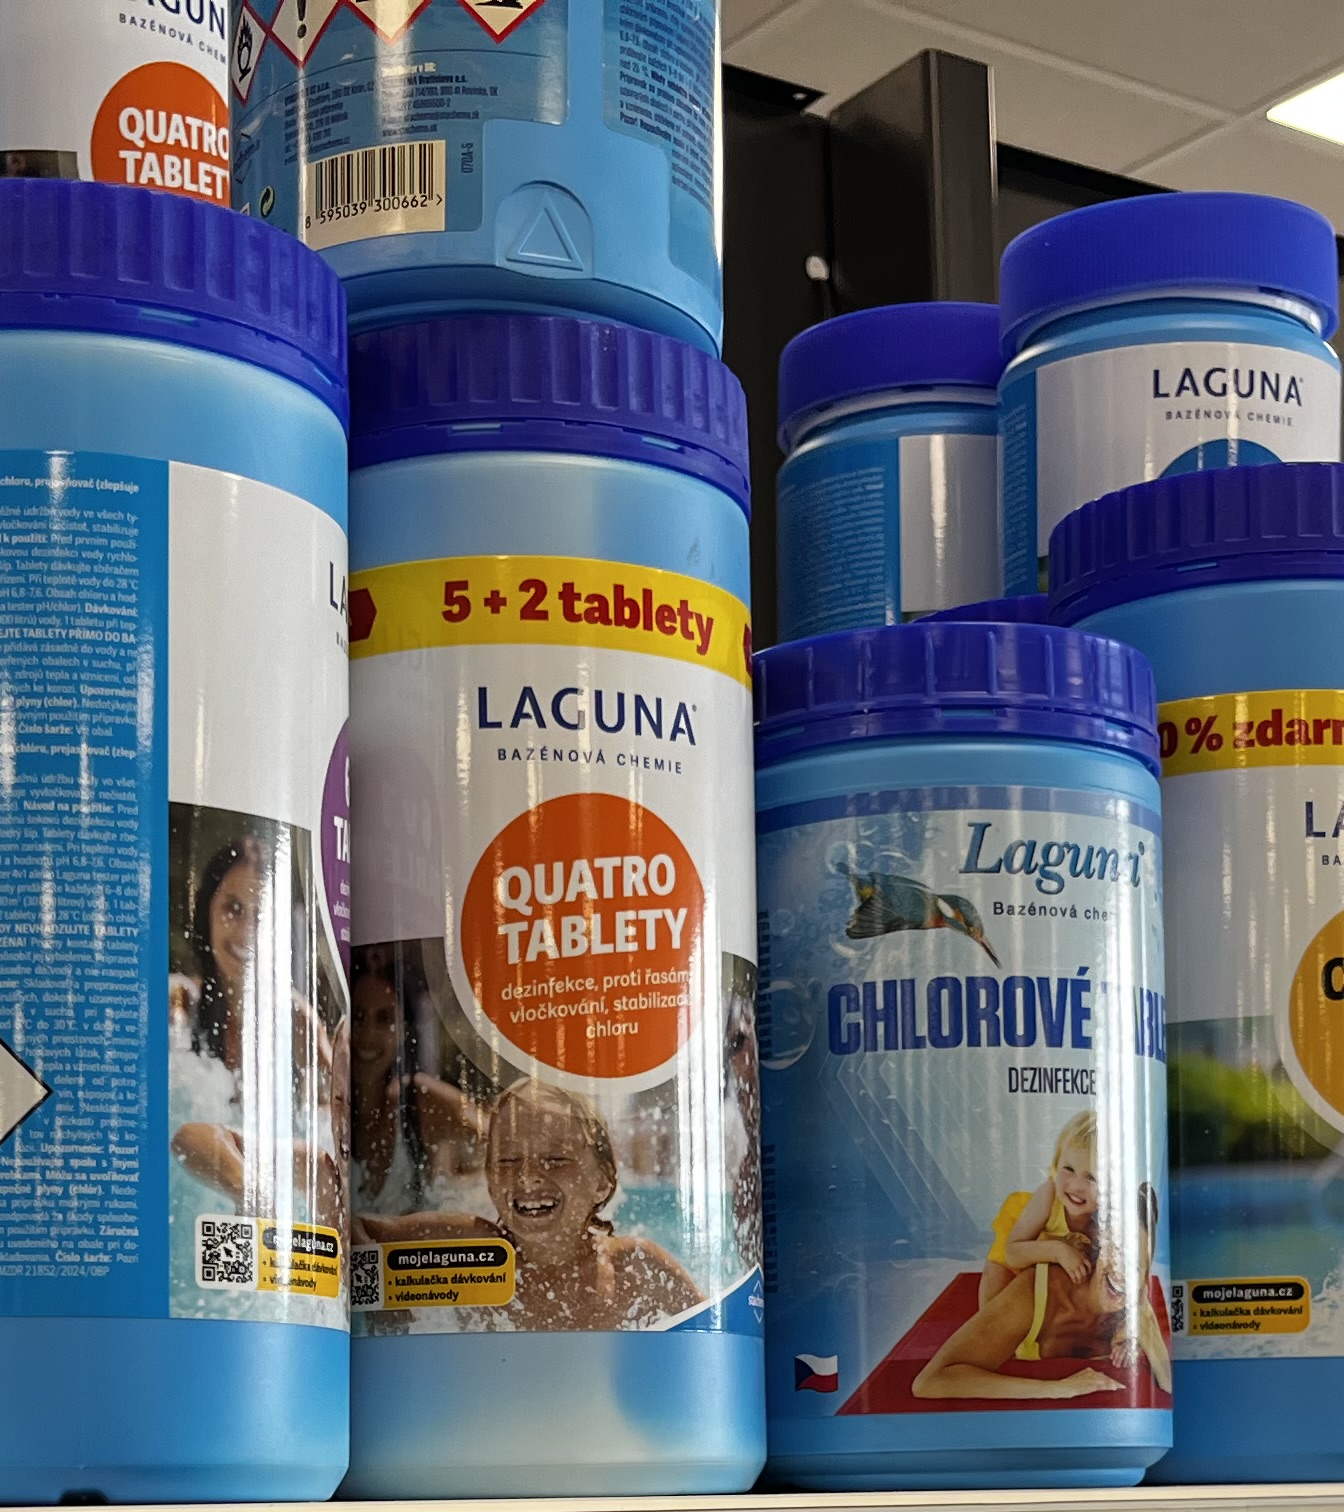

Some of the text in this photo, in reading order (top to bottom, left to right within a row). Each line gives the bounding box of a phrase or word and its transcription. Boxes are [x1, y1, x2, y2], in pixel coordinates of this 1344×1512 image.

[119, 106, 230, 157] QUATRO
[318, 193, 429, 226] 595039 300662
[1152, 366, 1304, 408] LAGUNA
[558, 581, 714, 656] tablety
[477, 686, 697, 747] LAGUNA
[616, 753, 683, 774] CHEMIE
[500, 853, 676, 915] QUATRO
[993, 901, 1079, 921] Bazénová
[498, 907, 689, 965] TABLETY
[509, 1000, 609, 1026] vločkování,
[827, 966, 1093, 1056] CHLOROVÉ
[586, 1020, 639, 1039] chloru
[1008, 1066, 1098, 1097] DEZINFEKCE
[397, 1249, 495, 1267] mojelaguna.cz
[394, 1274, 450, 1287] kalkulačka
[1202, 1286, 1294, 1301] mojelaguna.cz
